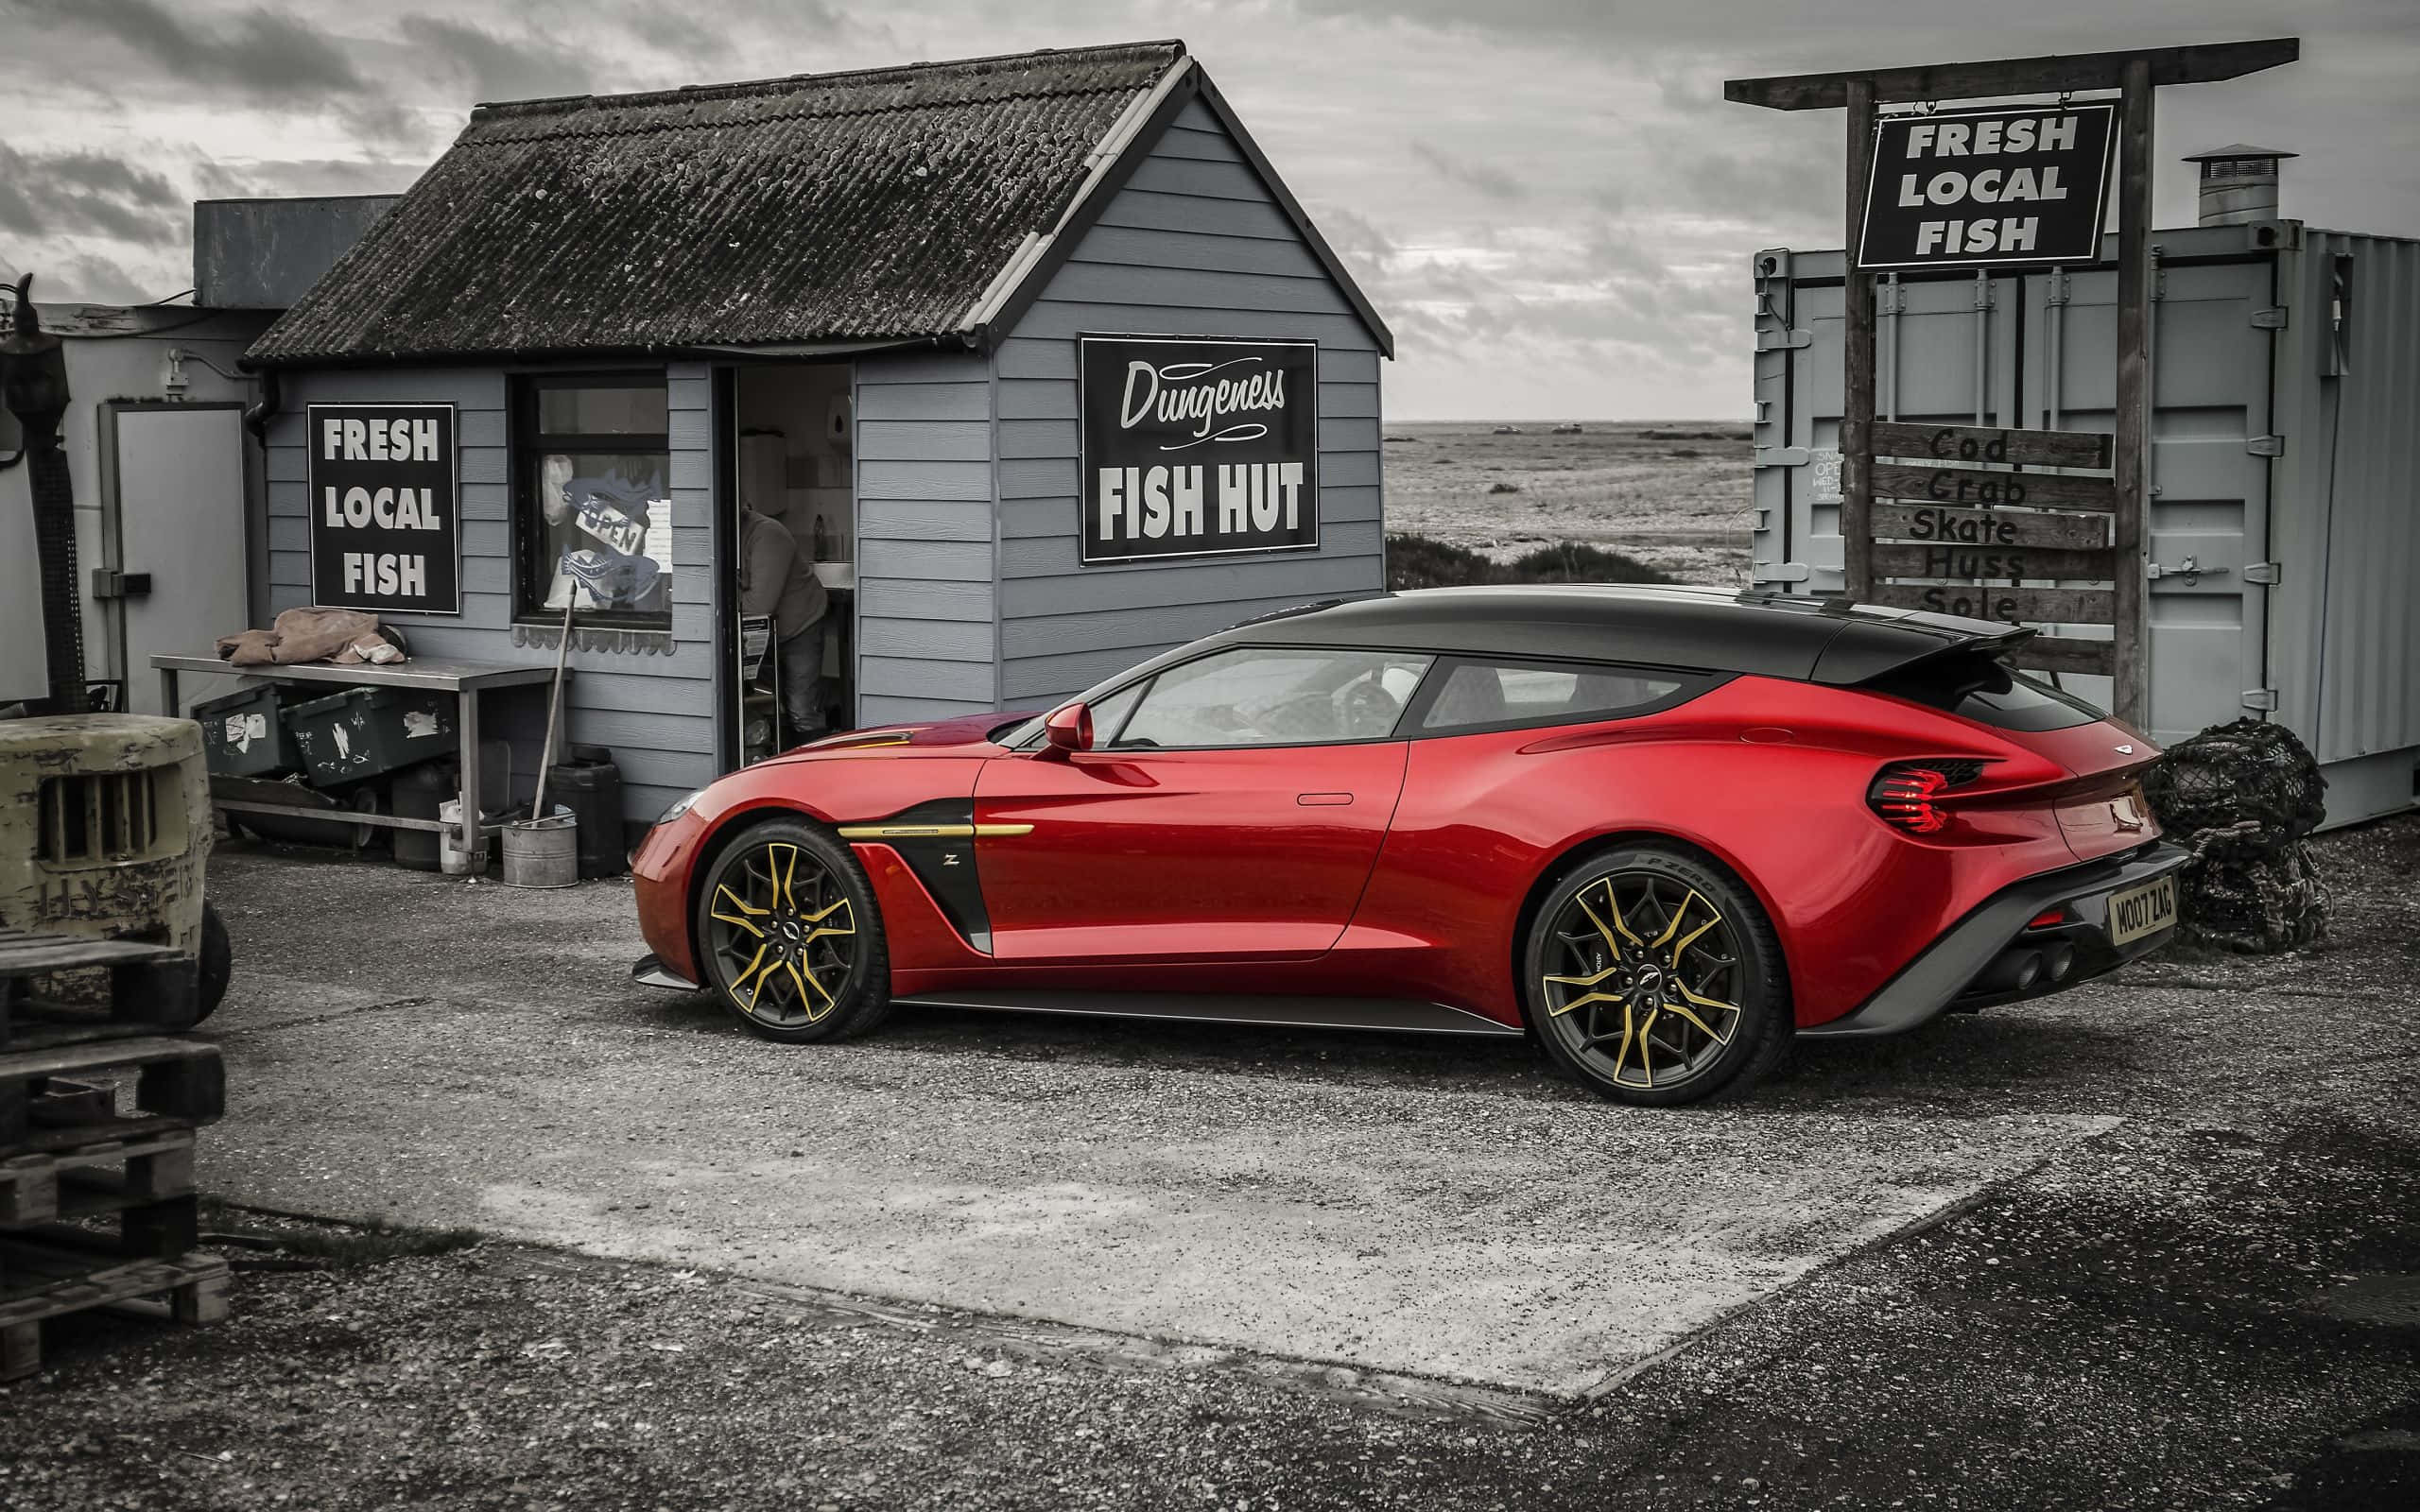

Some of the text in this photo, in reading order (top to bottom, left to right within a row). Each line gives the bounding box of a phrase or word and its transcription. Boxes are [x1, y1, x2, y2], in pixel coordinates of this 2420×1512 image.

[1906, 115, 2078, 159] FRESH
[1898, 166, 2068, 207] LOCAL
[1915, 216, 2039, 255] FISH
[1120, 360, 1285, 438] Dungeness
[323, 419, 440, 462] FRESH
[1930, 428, 2008, 460] Cod
[324, 486, 441, 531] LOCAL
[1098, 462, 1304, 541] FISH HUT
[1927, 472, 2026, 504] Crab
[1909, 508, 2017, 545] Skate
[343, 553, 426, 597] FISH
[1926, 546, 2026, 578] Huss
[1921, 587, 2018, 621] Sole
